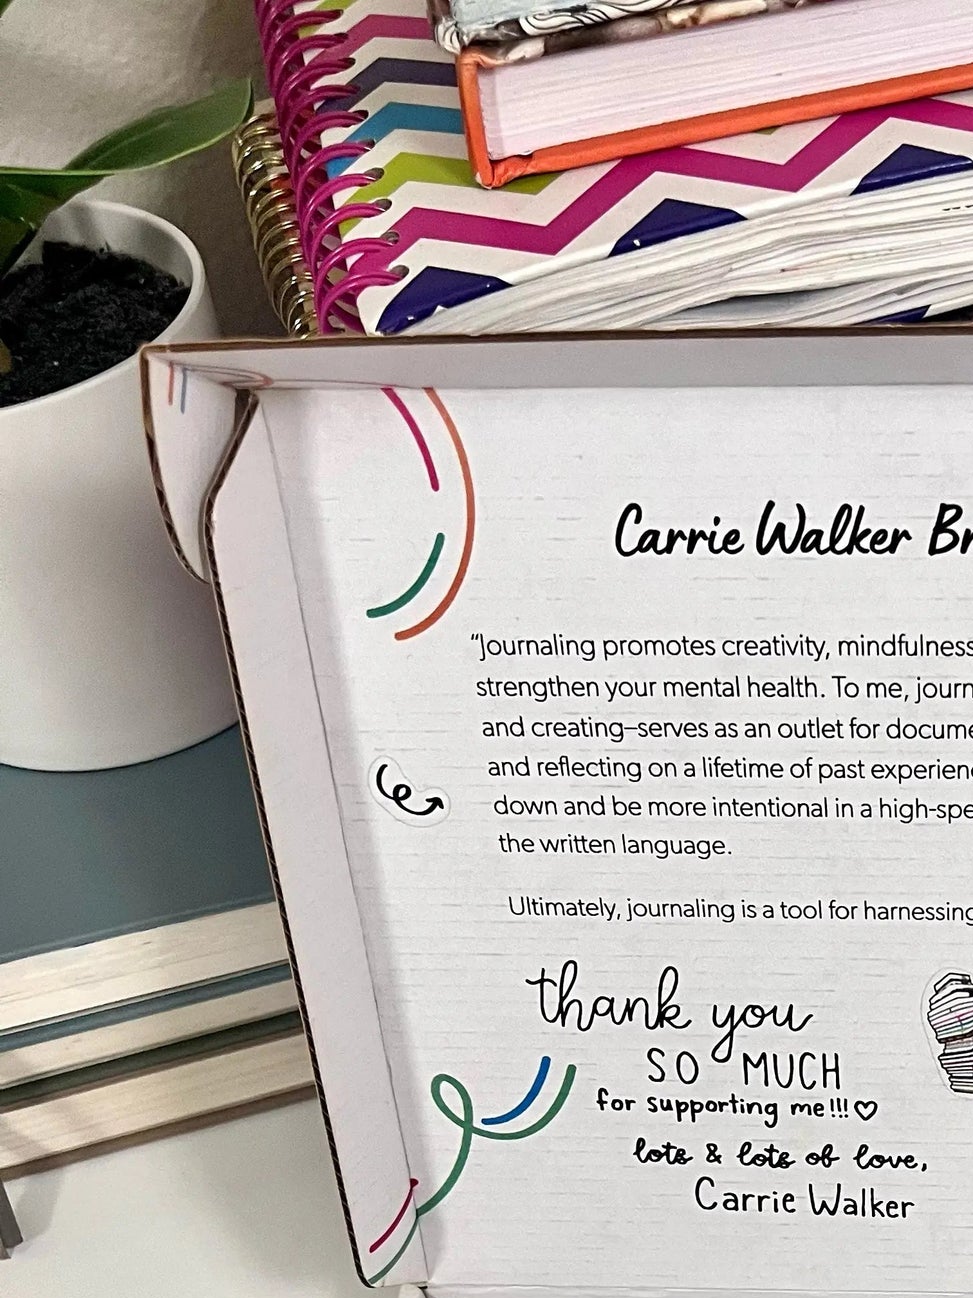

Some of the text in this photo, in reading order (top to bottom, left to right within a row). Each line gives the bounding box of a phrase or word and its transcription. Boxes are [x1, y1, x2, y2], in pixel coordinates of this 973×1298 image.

[614, 502, 746, 558] Carrie
[755, 499, 913, 556] Walker
[602, 635, 716, 661] promotes
[721, 633, 830, 662] creativity,
[476, 675, 600, 703] strengthen
[604, 681, 657, 703] your
[663, 675, 741, 698] mental
[747, 675, 825, 698] health.
[831, 675, 860, 698] To
[866, 682, 909, 703] me,
[482, 715, 525, 737] and
[714, 722, 739, 738] as
[744, 722, 771, 739] an
[777, 716, 845, 739] outlet
[849, 716, 881, 739] for
[488, 755, 531, 777] and
[537, 755, 642, 783] reflecting
[648, 762, 677, 778] on
[702, 755, 784, 779] lifetime
[789, 756, 813, 779] of
[818, 759, 866, 784] past
[493, 794, 558, 815] down
[564, 794, 606, 816] and
[611, 795, 642, 816] be
[648, 801, 707, 817] more
[712, 796, 828, 818] intentional
[835, 797, 854, 818] in
[498, 832, 732, 860] the written language.
[508, 896, 621, 922] Ultimately,
[626, 897, 735, 923] journaling
[741, 899, 757, 919] is
[779, 899, 823, 920] tool
[828, 899, 858, 920] for
[524, 959, 814, 1064] thank you
[646, 1047, 841, 1091] SO MUCH
[595, 1087, 637, 1112] for
[646, 1092, 779, 1129] supporting
[632, 1136, 928, 1173] lots & lots of love,
[694, 1175, 916, 1219] Carrie Walker
